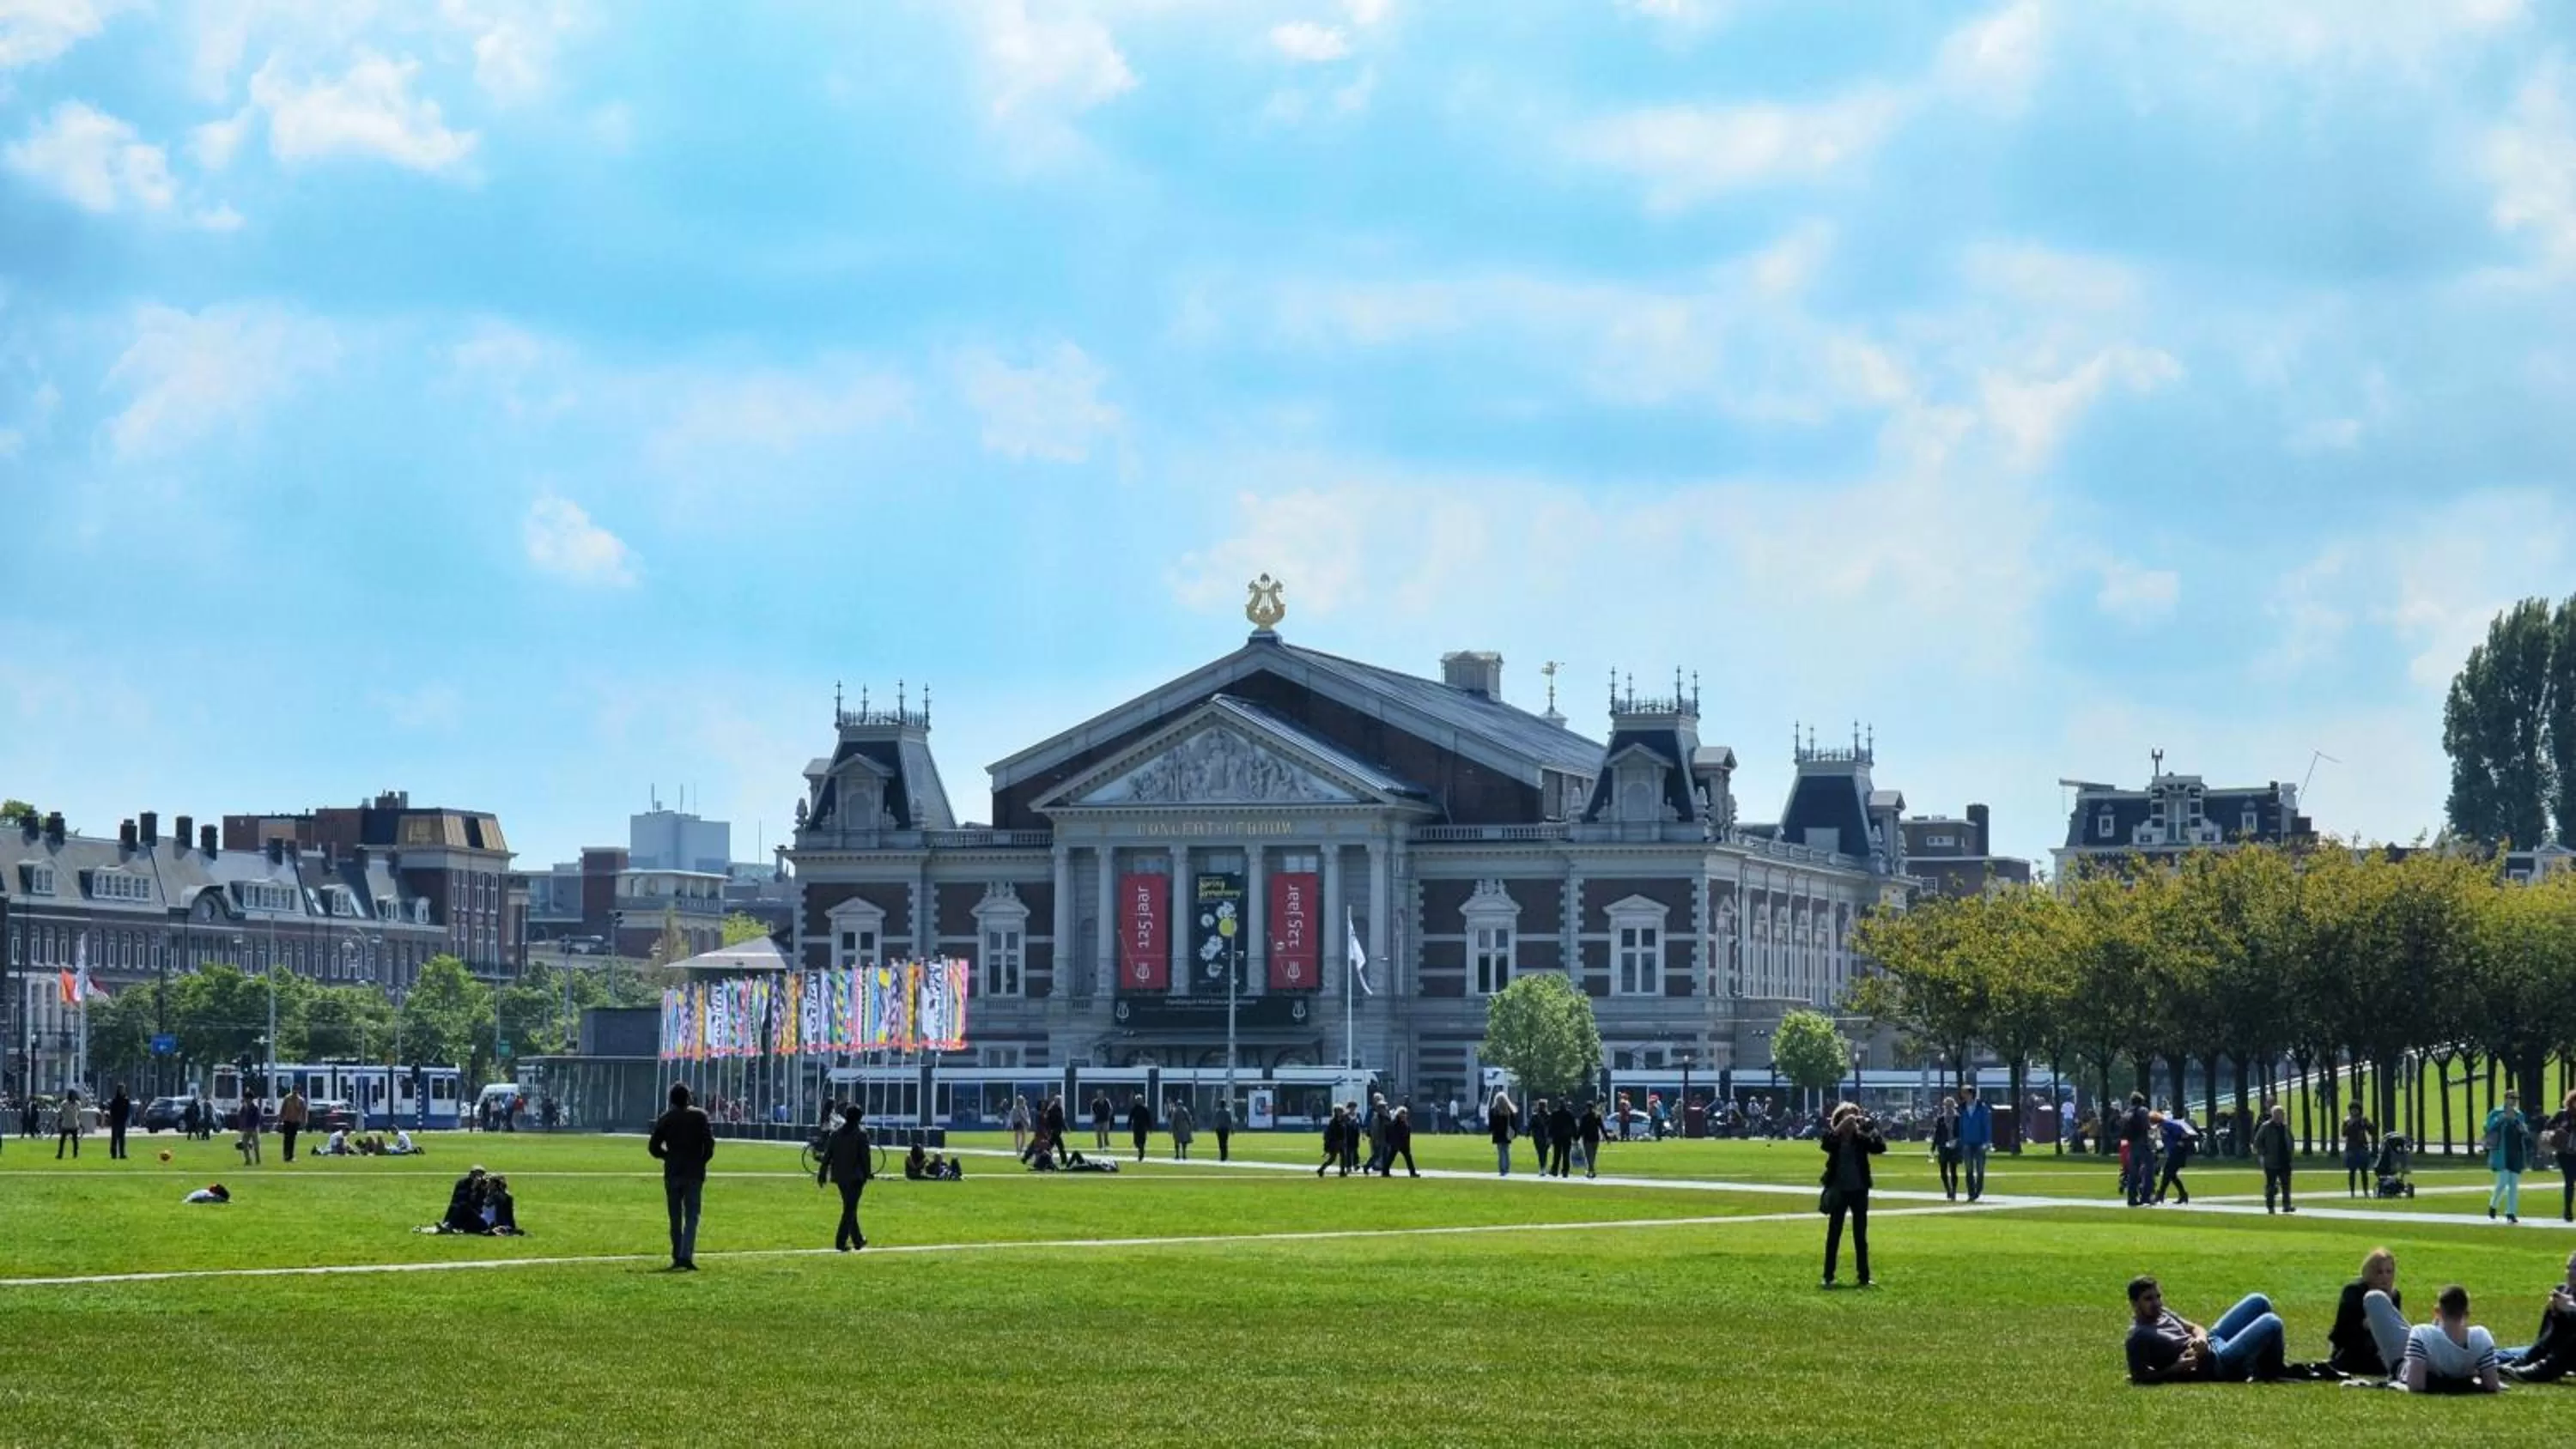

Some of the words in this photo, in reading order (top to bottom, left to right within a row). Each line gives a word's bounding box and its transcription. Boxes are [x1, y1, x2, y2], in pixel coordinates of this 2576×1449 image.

[1135, 885, 1153, 919] jaar
[1285, 884, 1304, 918] jaar
[1138, 920, 1153, 949] 125
[1288, 919, 1303, 948] 125
